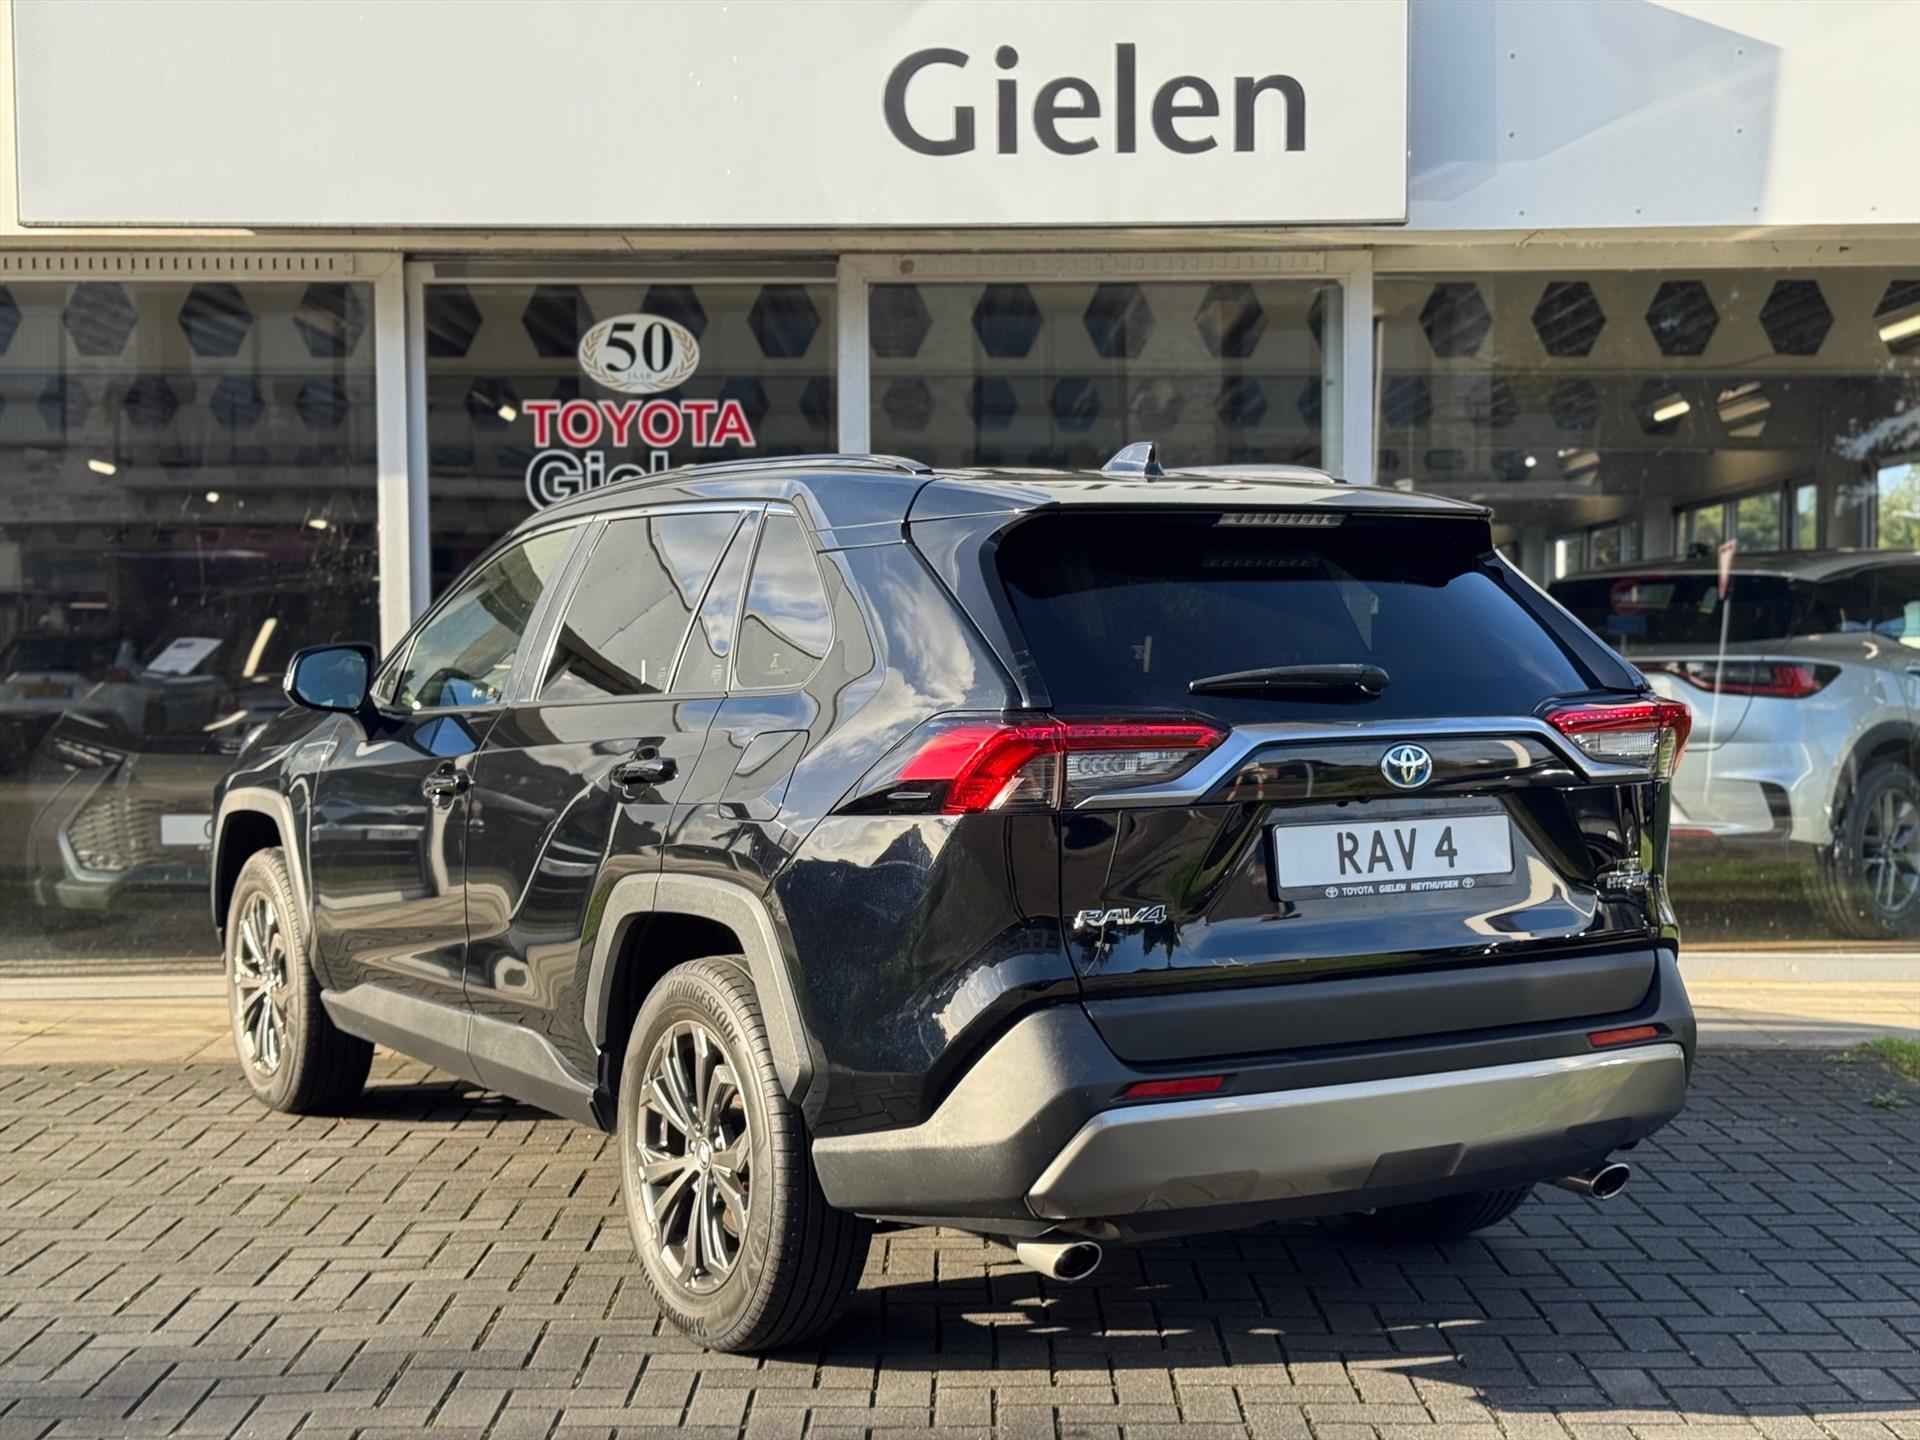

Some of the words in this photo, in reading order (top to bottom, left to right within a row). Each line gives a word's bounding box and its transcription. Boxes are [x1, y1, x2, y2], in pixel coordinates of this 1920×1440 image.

[883, 42, 1306, 157] Gielen
[605, 322, 673, 373] 50
[522, 400, 756, 447] TOYOTA
[1336, 827, 1417, 875] RAV
[1434, 825, 1458, 868] 4
[1342, 885, 1374, 896] TOYOTA
[1379, 882, 1406, 893] GIELEN
[1073, 905, 1167, 929] RAV4
[666, 980, 741, 1051] BRIDGESTONE
